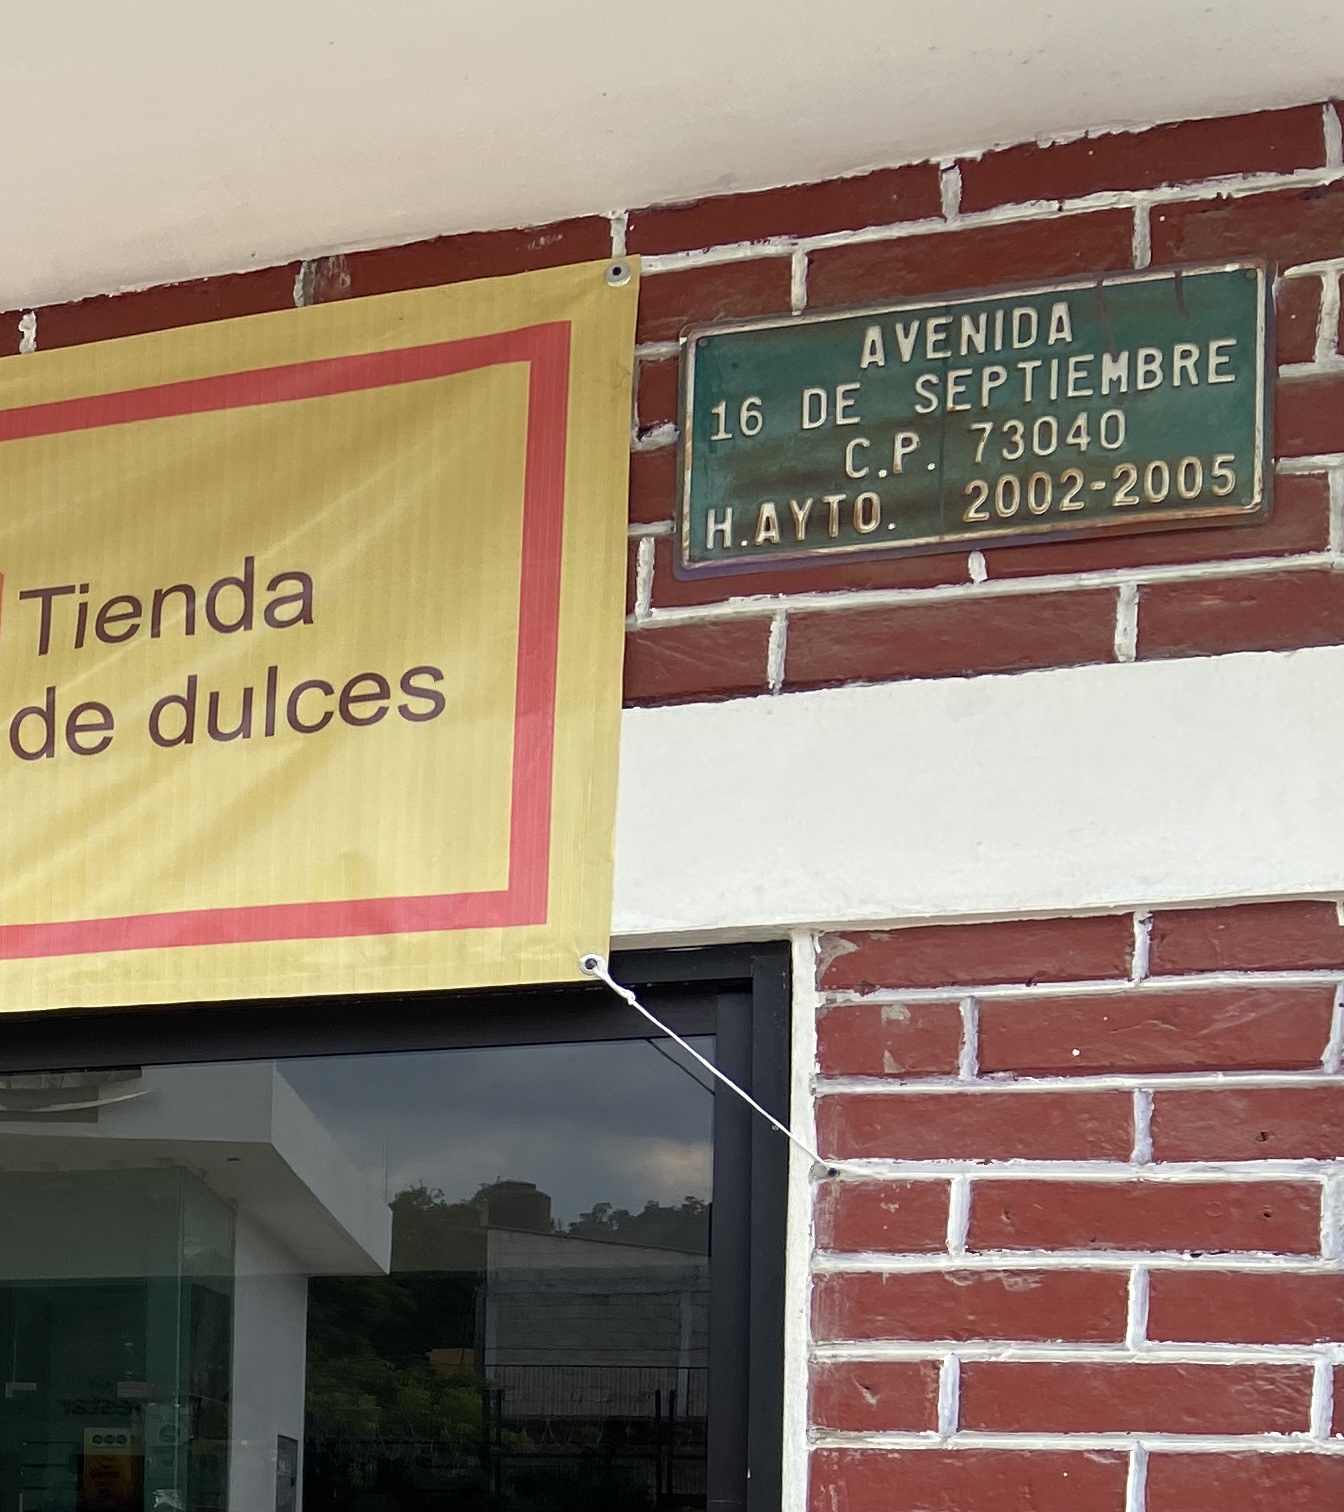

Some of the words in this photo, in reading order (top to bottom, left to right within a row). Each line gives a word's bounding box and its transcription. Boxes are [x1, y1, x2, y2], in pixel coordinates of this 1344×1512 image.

[860, 302, 1073, 369] AVENIDA
[711, 397, 764, 441] 16
[801, 382, 863, 430] DE
[914, 338, 1237, 414] SEPTIEMBRE
[846, 432, 937, 479] C.P.
[970, 409, 1126, 464] 73040
[705, 491, 897, 549] H.AYTO.
[964, 454, 1237, 522] 2002-2005
[19, 556, 314, 656] Tienda
[9, 686, 114, 761] de
[148, 665, 447, 748] dulces
